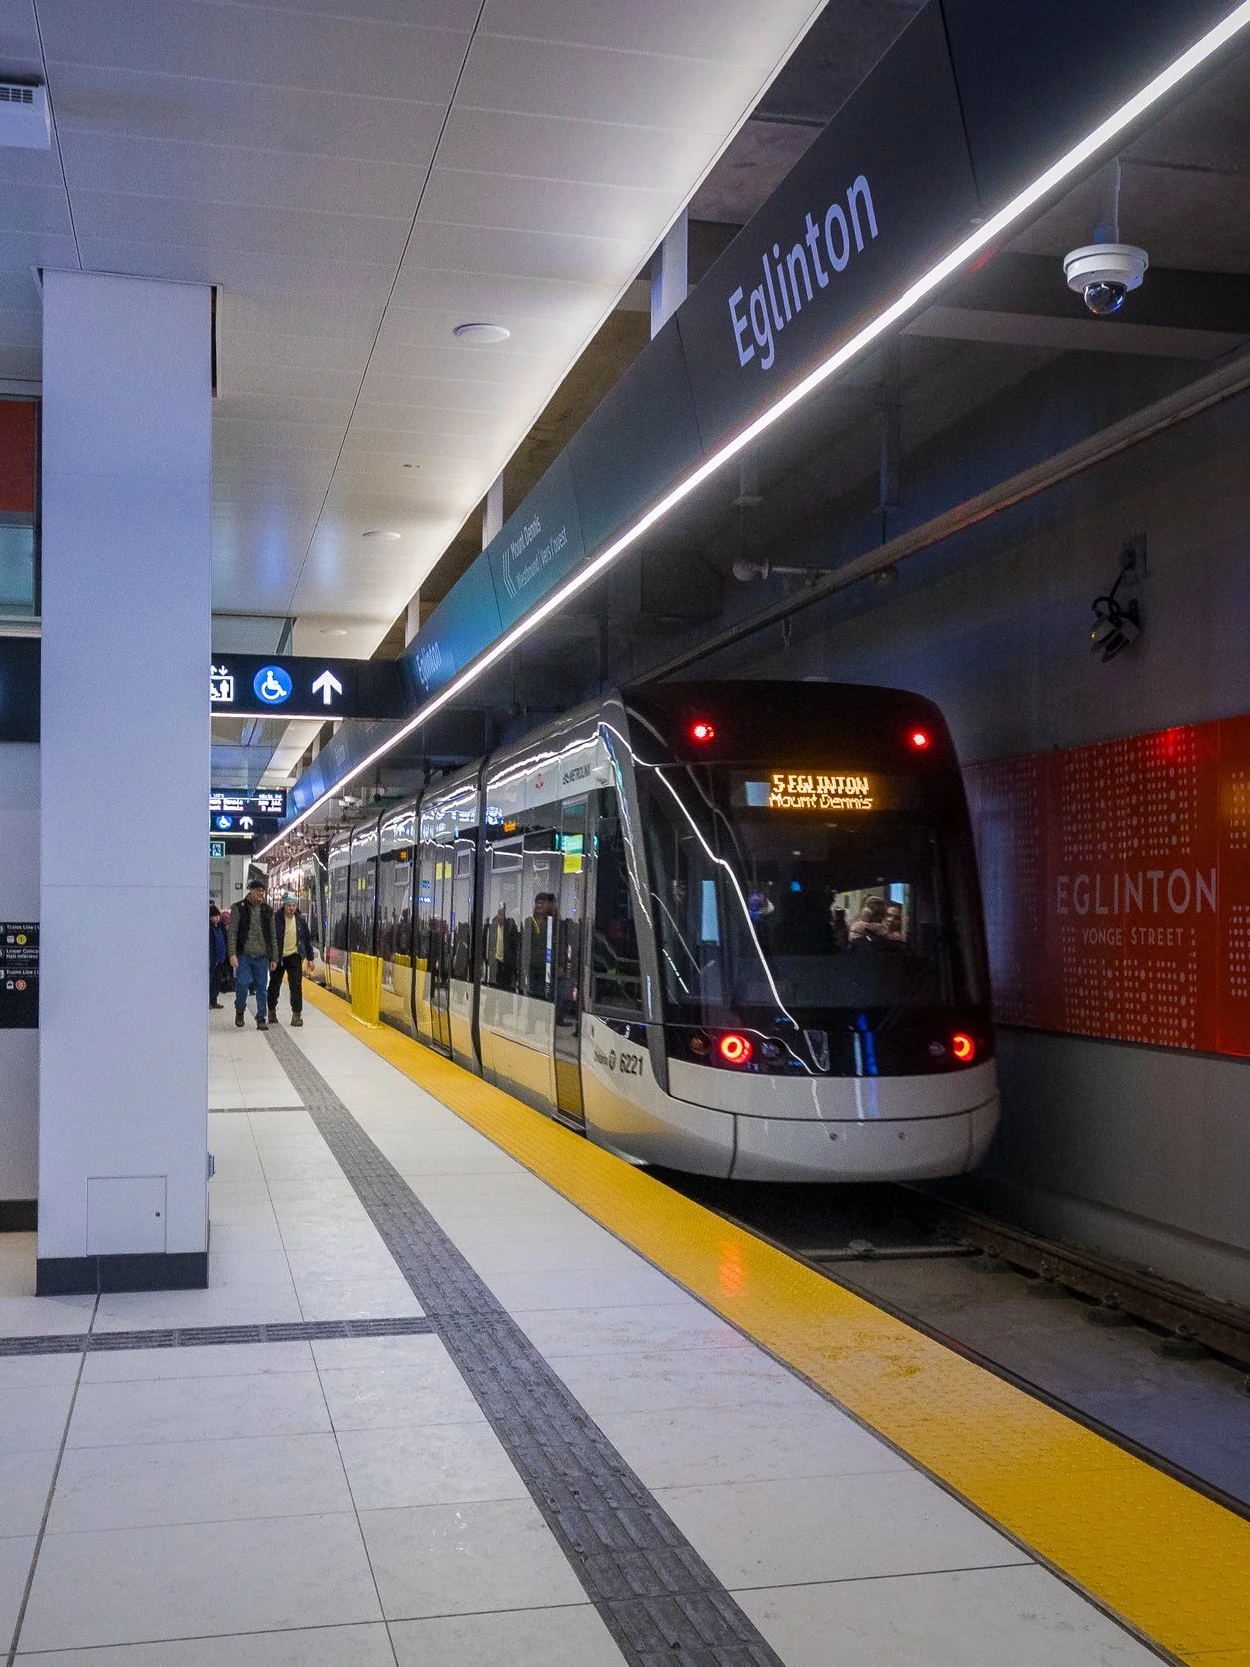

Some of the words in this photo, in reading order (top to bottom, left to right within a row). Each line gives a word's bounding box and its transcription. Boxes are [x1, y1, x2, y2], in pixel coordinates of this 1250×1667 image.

[728, 174, 879, 370] Eglinton
[523, 514, 541, 546] Dennis
[415, 641, 443, 691] Eglinton
[772, 774, 786, 793] 5
[786, 775, 870, 795] EGLINTON
[769, 792, 818, 808] Mount
[819, 793, 874, 809] Dennis
[1055, 867, 1218, 916] EGLINTON
[1081, 927, 1123, 946] YONGE
[1130, 927, 1184, 947] STREET
[619, 1052, 644, 1076] 6221
